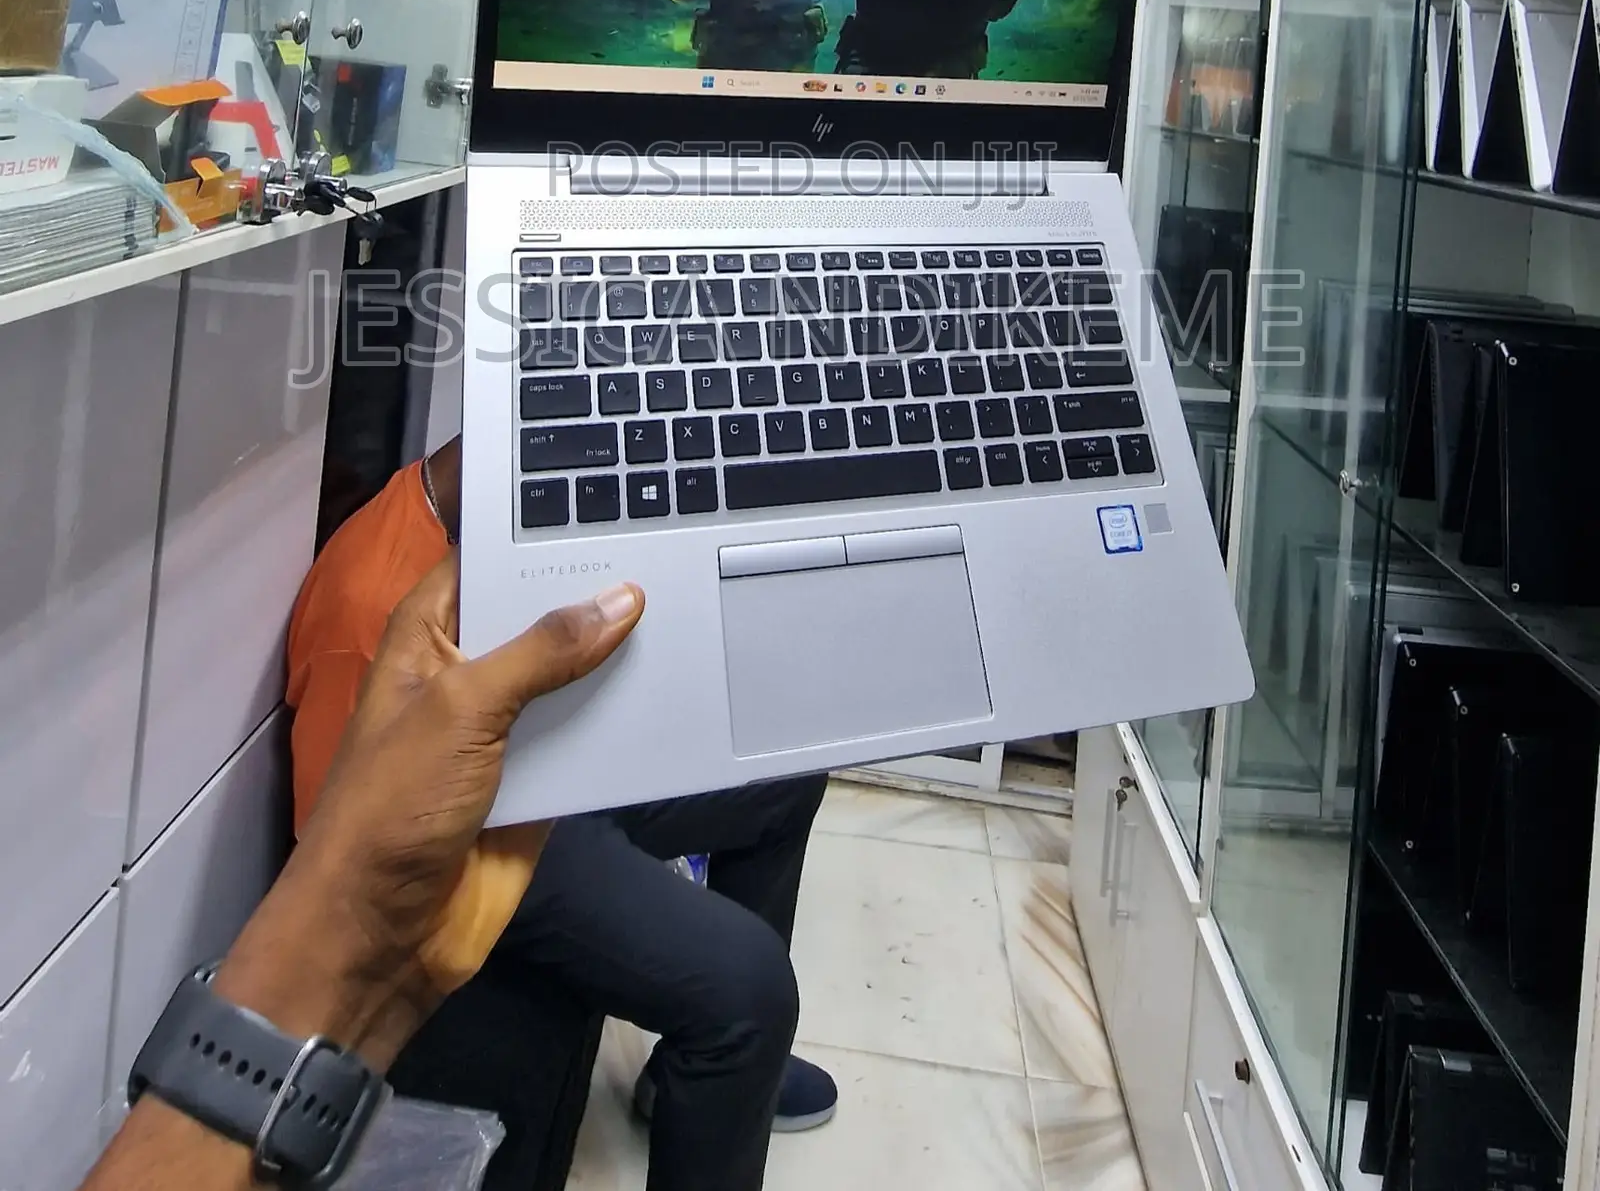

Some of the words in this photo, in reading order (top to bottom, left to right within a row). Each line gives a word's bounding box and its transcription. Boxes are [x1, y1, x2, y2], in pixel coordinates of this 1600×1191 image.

[812, 113, 834, 142] hp
[819, 324, 828, 335] Y
[860, 323, 869, 334] U
[939, 320, 949, 331] O
[978, 319, 986, 329] P
[641, 331, 654, 342] W
[687, 331, 696, 341] E
[732, 329, 742, 340] R
[775, 327, 785, 338] T
[878, 367, 885, 378] J
[917, 365, 927, 376] K
[958, 363, 966, 374] L
[747, 374, 755, 385] F
[792, 372, 802, 383] G
[835, 370, 844, 381] H
[529, 383, 547, 392] caps
[548, 382, 564, 391] lock
[607, 382, 617, 392] A
[655, 378, 665, 390] S
[702, 376, 711, 387] D
[862, 414, 872, 426] N
[905, 410, 916, 423] M
[730, 423, 740, 435] C
[775, 420, 784, 432] V
[818, 418, 828, 430] B
[634, 429, 644, 441] Z
[683, 426, 693, 438] X
[529, 434, 547, 445] shift
[686, 477, 697, 486] alt
[530, 488, 545, 498] ctrl
[586, 485, 594, 495] fn
[520, 560, 612, 579] ELITEBOOK
